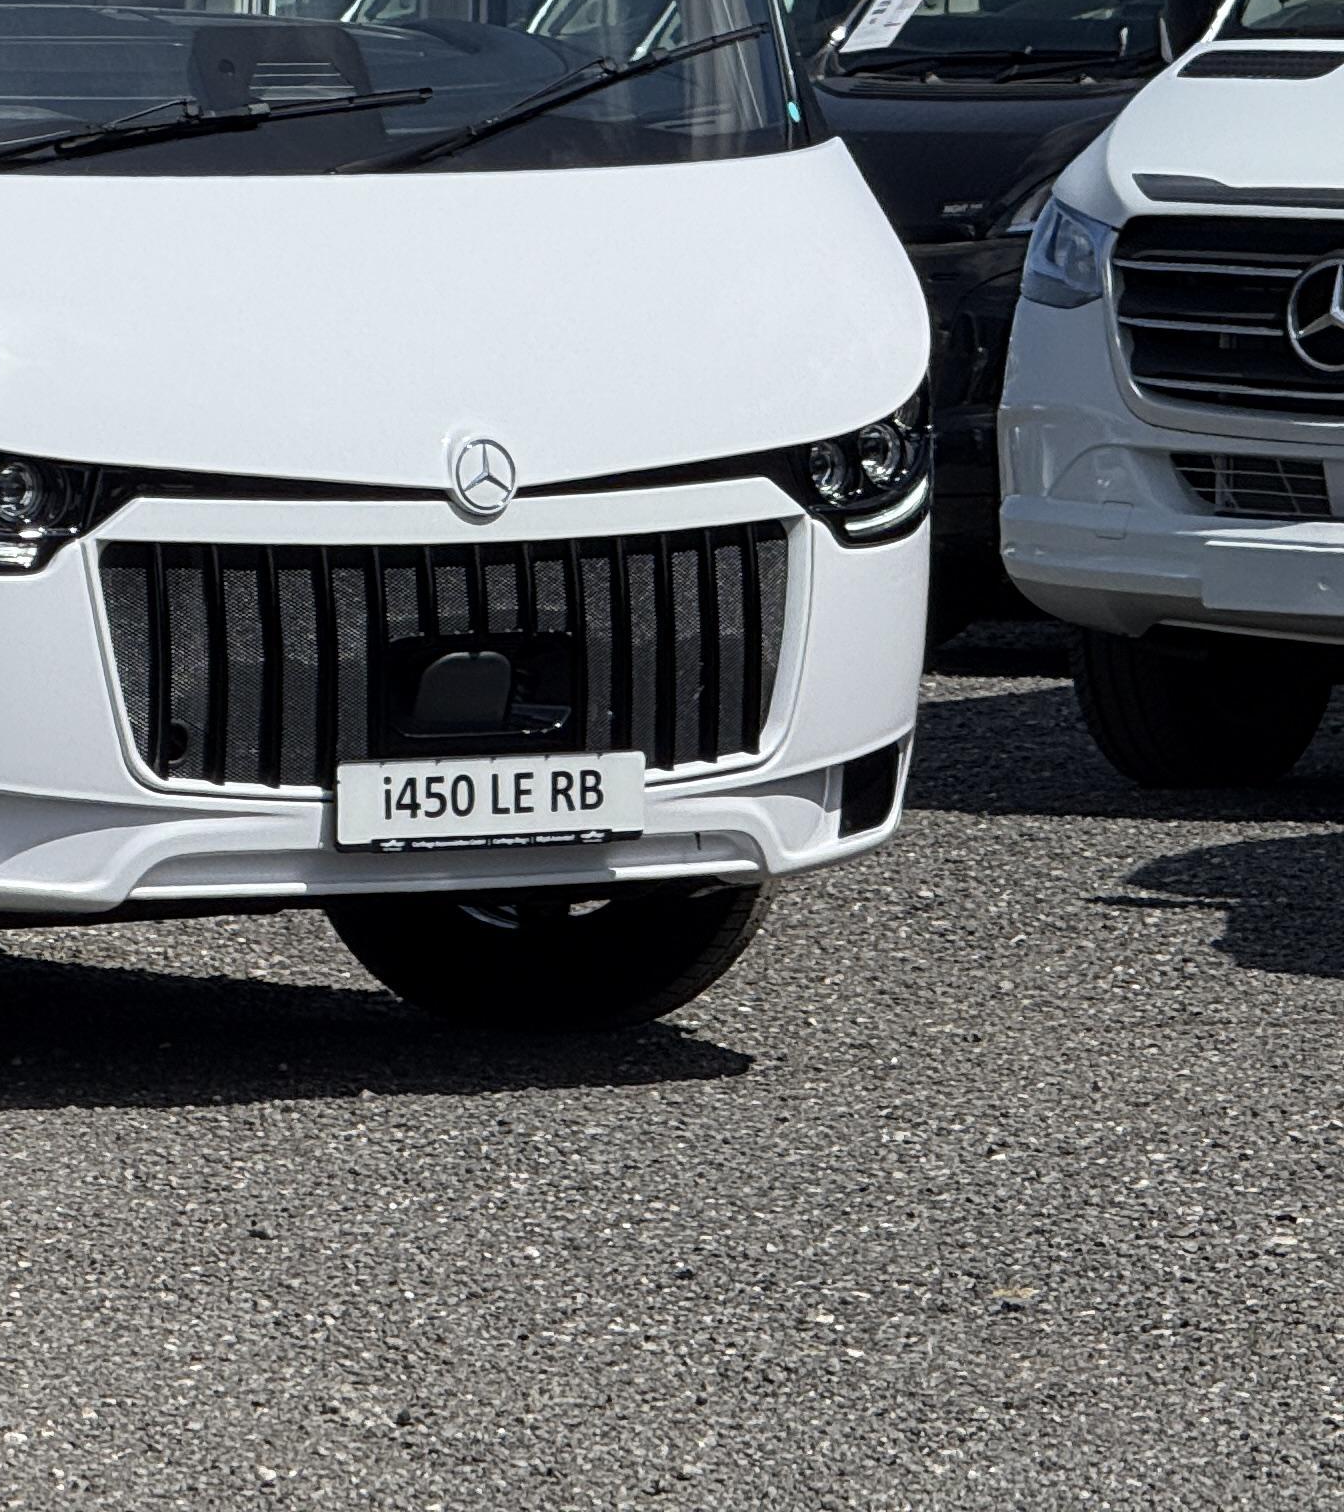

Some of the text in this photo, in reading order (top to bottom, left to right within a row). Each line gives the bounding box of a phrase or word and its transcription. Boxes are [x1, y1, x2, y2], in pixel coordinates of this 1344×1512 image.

[383, 769, 605, 820] i450 LE RB
